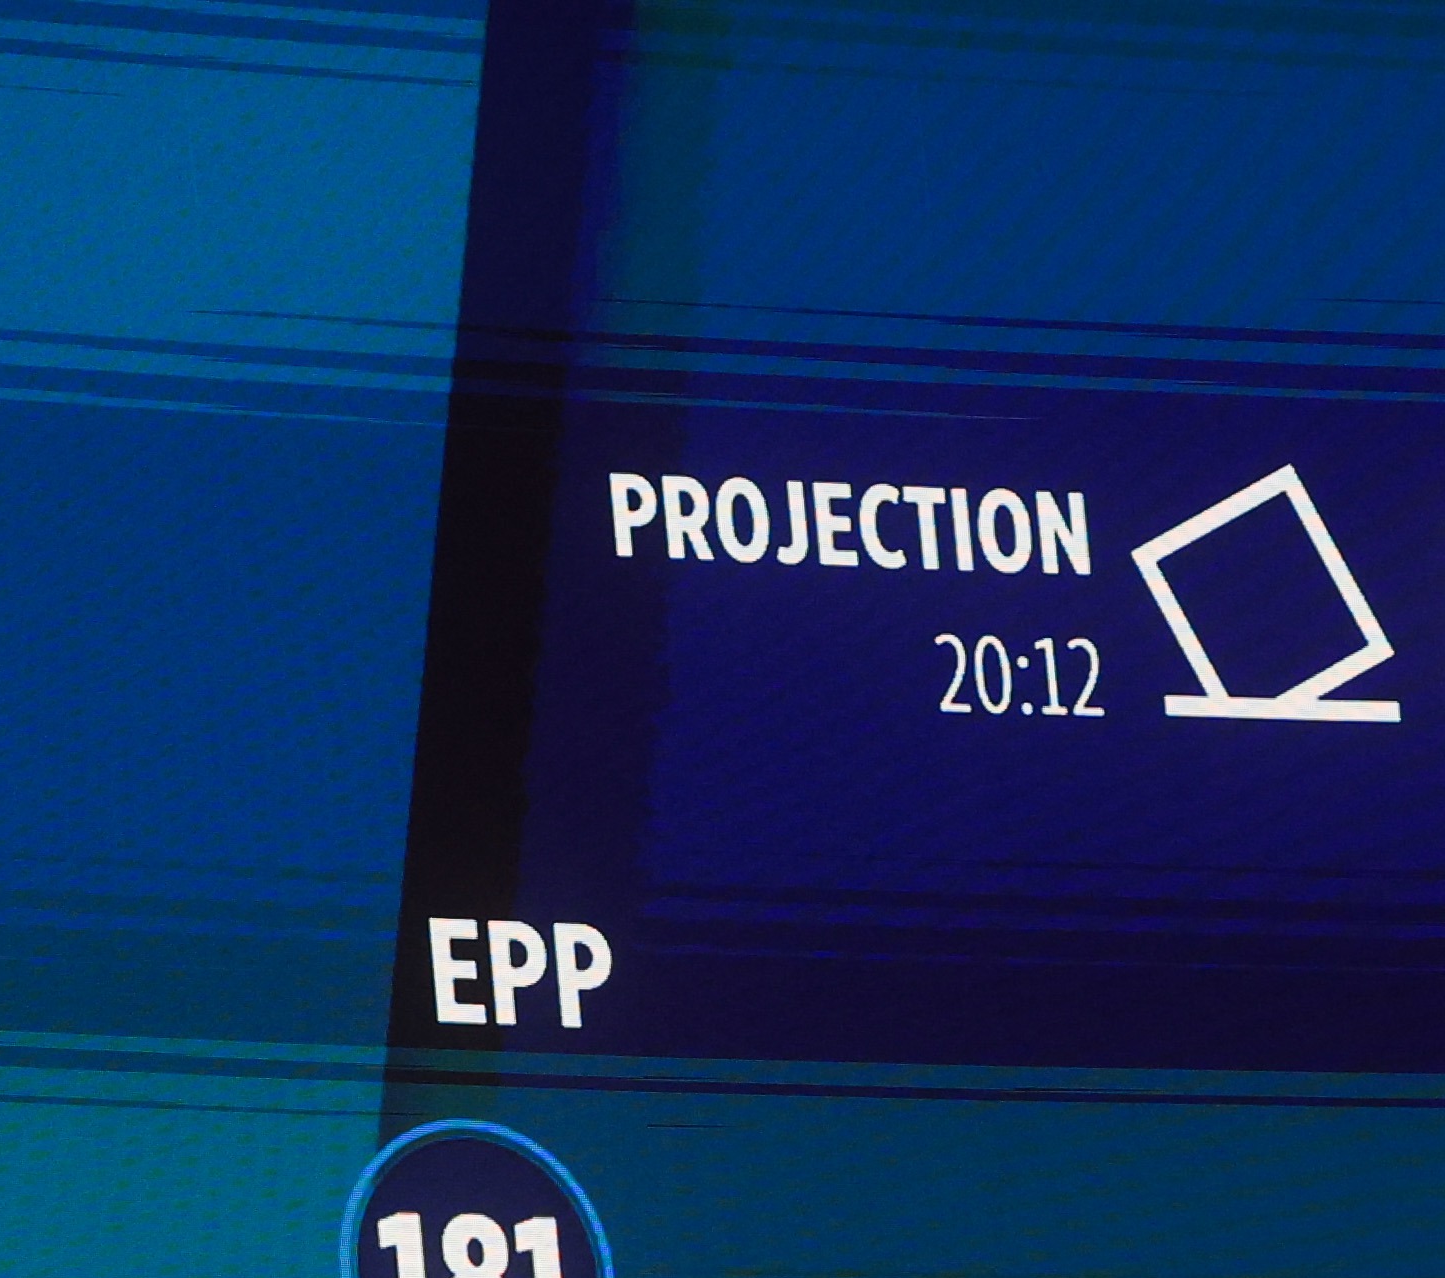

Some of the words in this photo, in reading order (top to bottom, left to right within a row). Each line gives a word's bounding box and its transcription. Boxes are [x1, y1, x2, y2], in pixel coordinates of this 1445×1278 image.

[611, 474, 1090, 574] PROJECTION
[937, 635, 1102, 715] 20:12
[430, 919, 611, 1027] EPP
